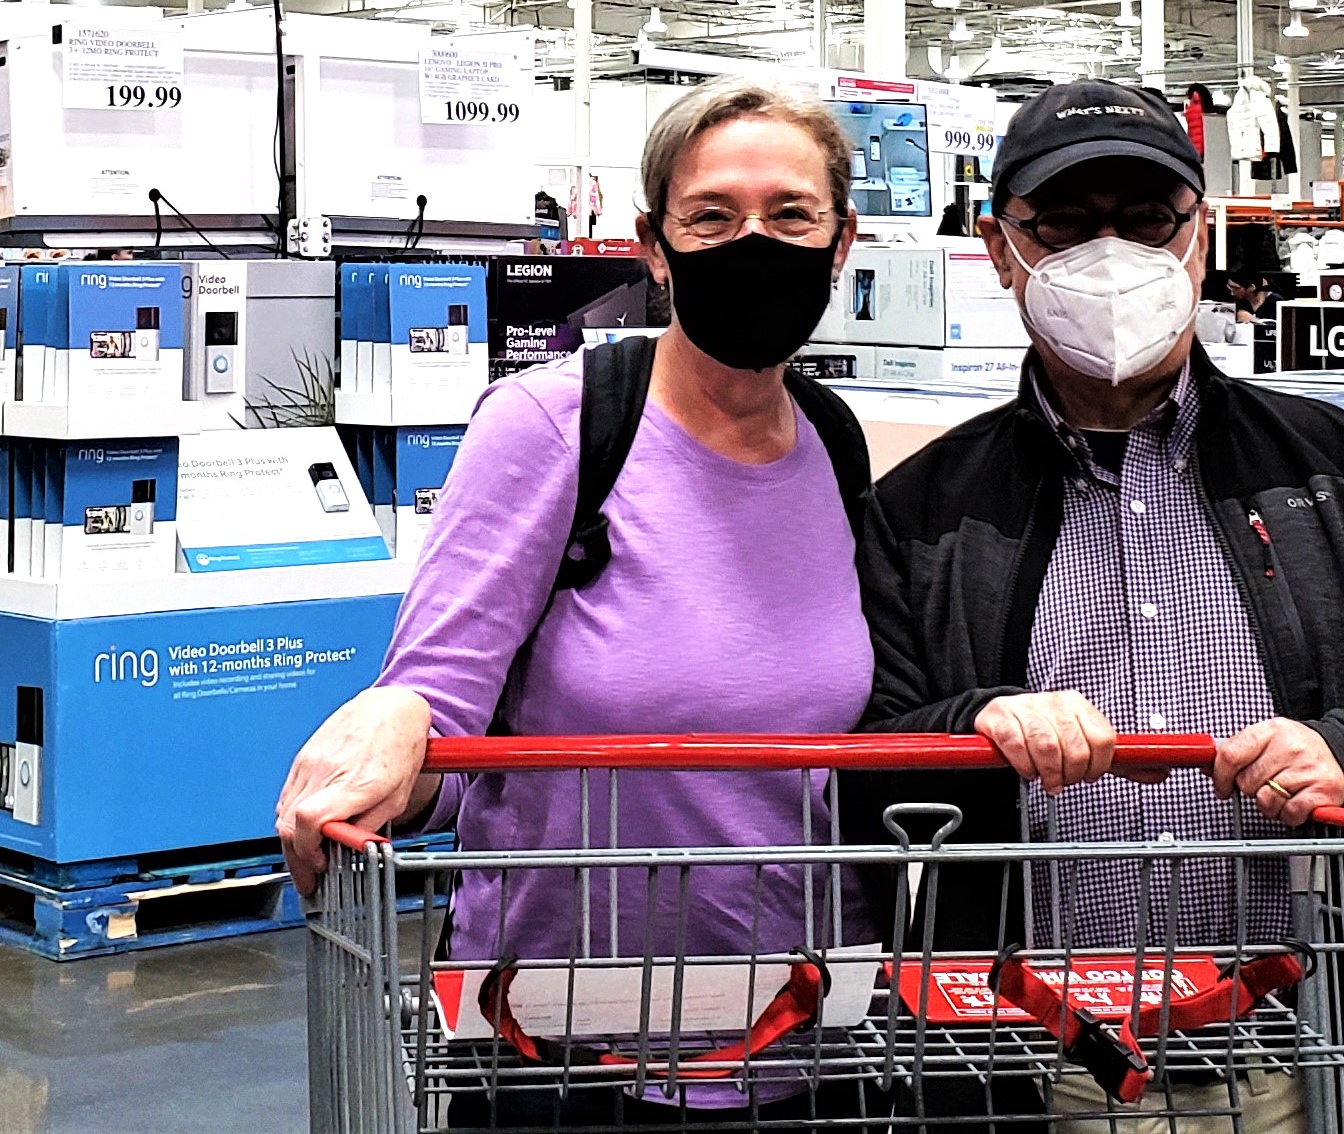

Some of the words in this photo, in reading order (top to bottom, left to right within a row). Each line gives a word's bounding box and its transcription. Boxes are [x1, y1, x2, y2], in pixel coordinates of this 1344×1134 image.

[90, 39, 114, 47] VIDEO
[125, 49, 159, 57] PROTECT
[106, 85, 182, 108] 199.99
[445, 101, 519, 123] 1099.99
[945, 130, 994, 152] 999.99
[506, 265, 552, 276] LEGION
[81, 275, 107, 288] ring
[198, 275, 226, 283] Video
[399, 274, 422, 289] ring
[198, 285, 240, 295] Doorbell
[506, 325, 556, 337] Pro-Level
[506, 337, 547, 349] Gaming
[951, 362, 984, 373] Inspiron
[407, 434, 430, 449] ring
[78, 448, 104, 463] ring
[191, 458, 235, 468] Doorbell
[1287, 491, 1332, 507] ORVS
[169, 647, 206, 660] Video
[209, 638, 264, 656] Doorbell
[266, 637, 275, 650] 3
[277, 637, 303, 650] Plus
[94, 645, 159, 687] ring
[169, 661, 198, 676] with
[201, 655, 271, 674] 12-months
[273, 651, 303, 668] Ring
